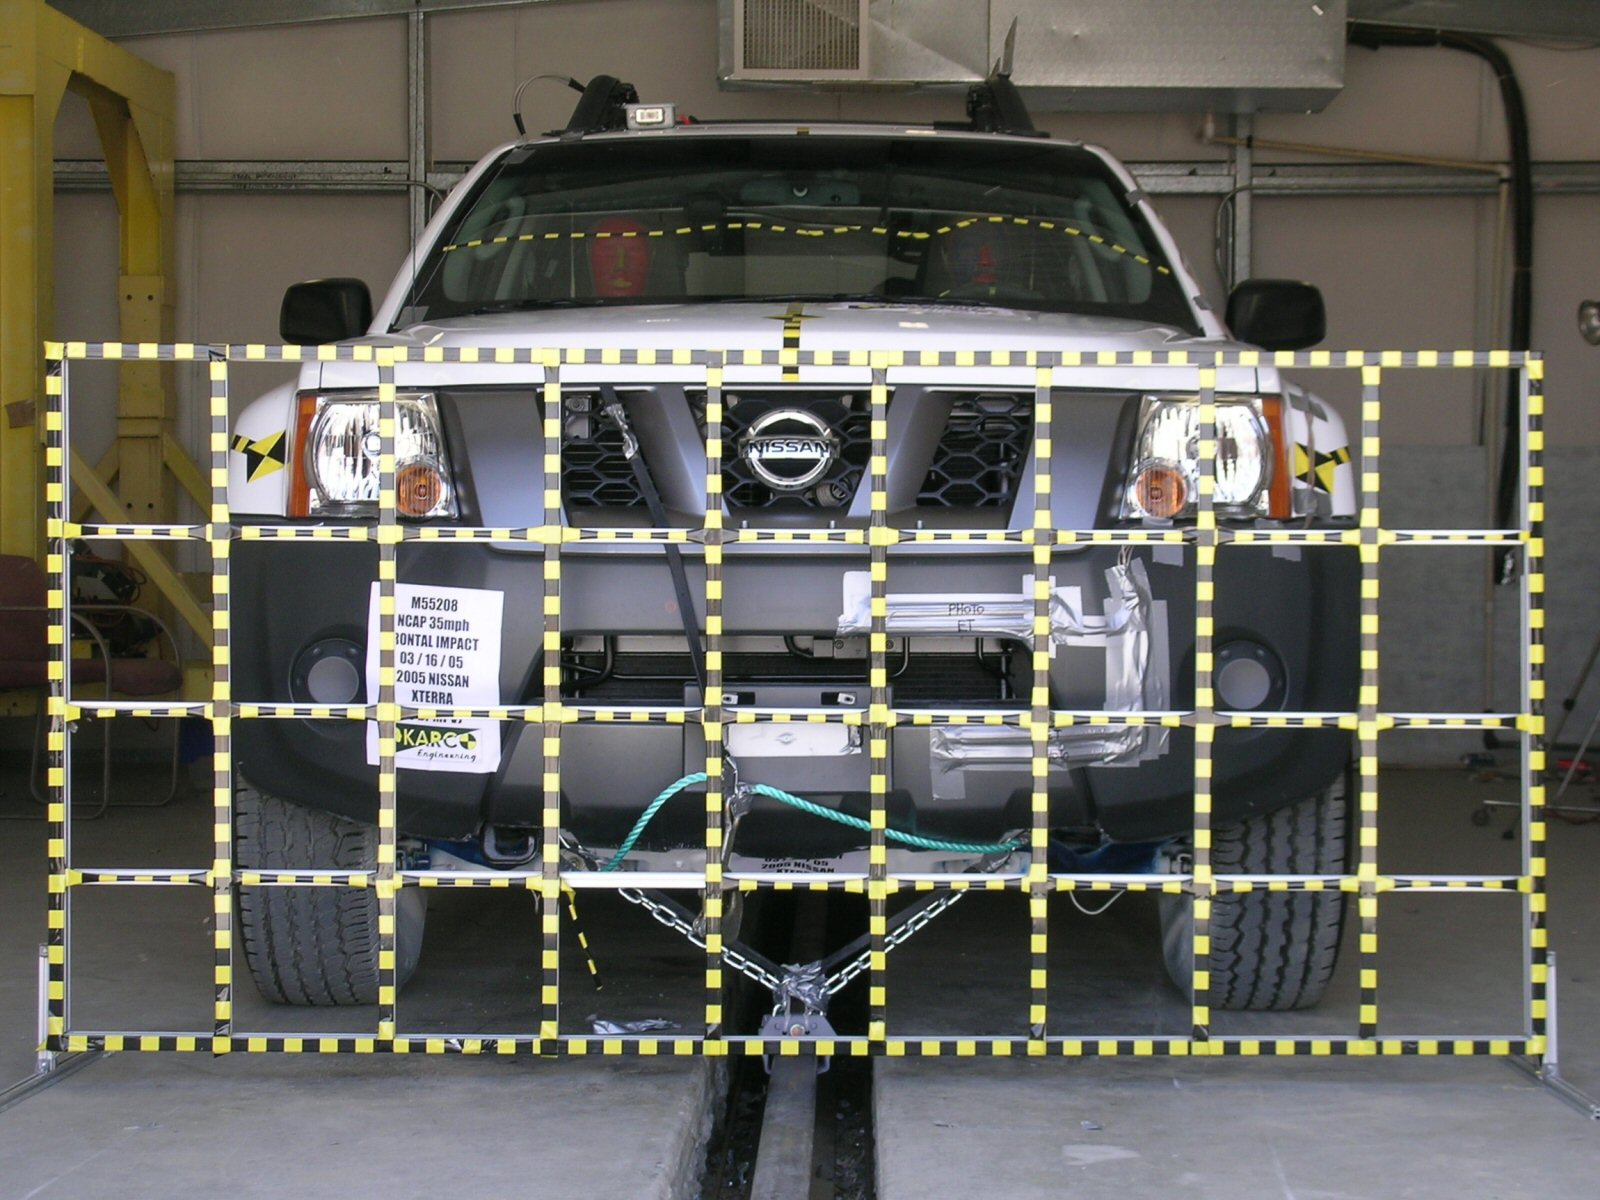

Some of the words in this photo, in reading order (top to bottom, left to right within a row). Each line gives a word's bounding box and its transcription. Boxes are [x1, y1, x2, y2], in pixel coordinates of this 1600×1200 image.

[748, 440, 830, 458] NISSAN
[411, 596, 458, 612] M55208
[397, 614, 427, 628] NCAP
[429, 616, 470, 632] 35mph
[395, 632, 433, 648] RONTAL
[436, 636, 479, 651] IMPACT
[400, 651, 414, 665] 03
[425, 653, 437, 667] 16
[448, 655, 463, 669] 05
[396, 669, 426, 684] 2005
[428, 672, 469, 688] NISSAN
[411, 689, 453, 705] XTERRA
[417, 749, 477, 762] Engineering
[793, 861, 835, 873] NISSAN
